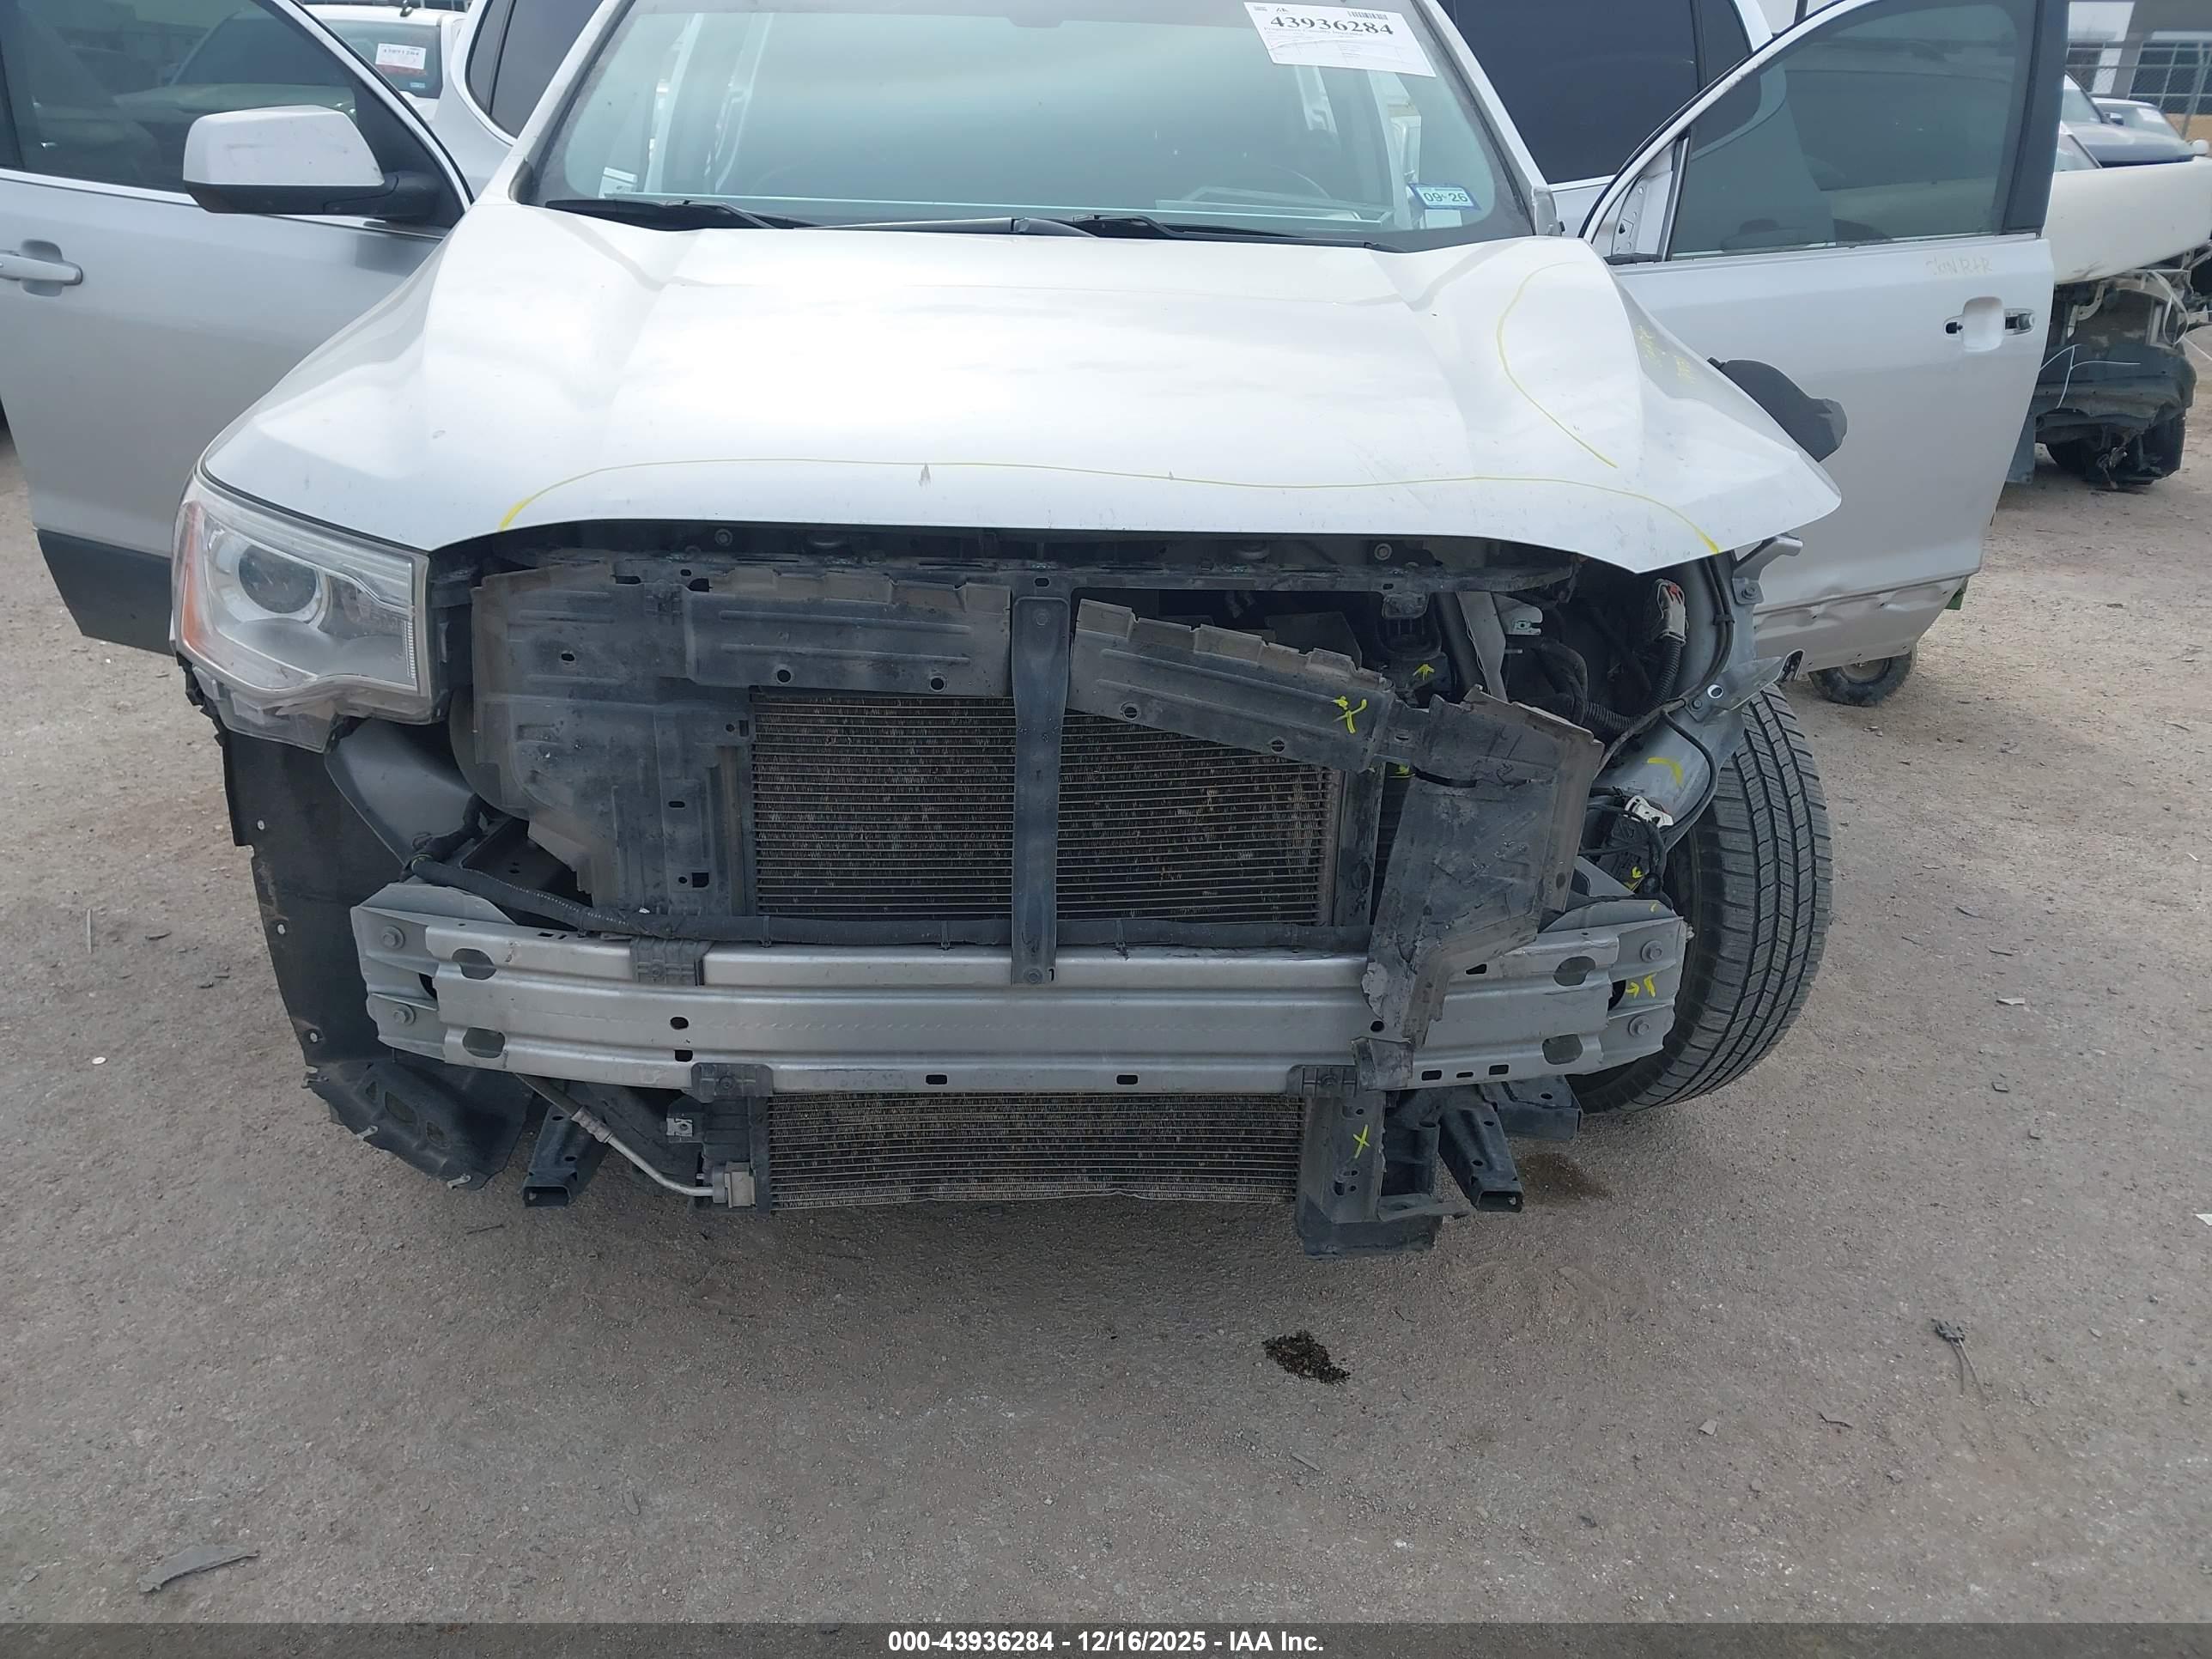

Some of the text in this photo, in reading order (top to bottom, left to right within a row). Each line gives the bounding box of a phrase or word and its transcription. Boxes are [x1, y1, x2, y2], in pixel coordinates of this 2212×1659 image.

[1270, 15, 1394, 35] 43936284
[1424, 192, 1468, 202] 09 26
